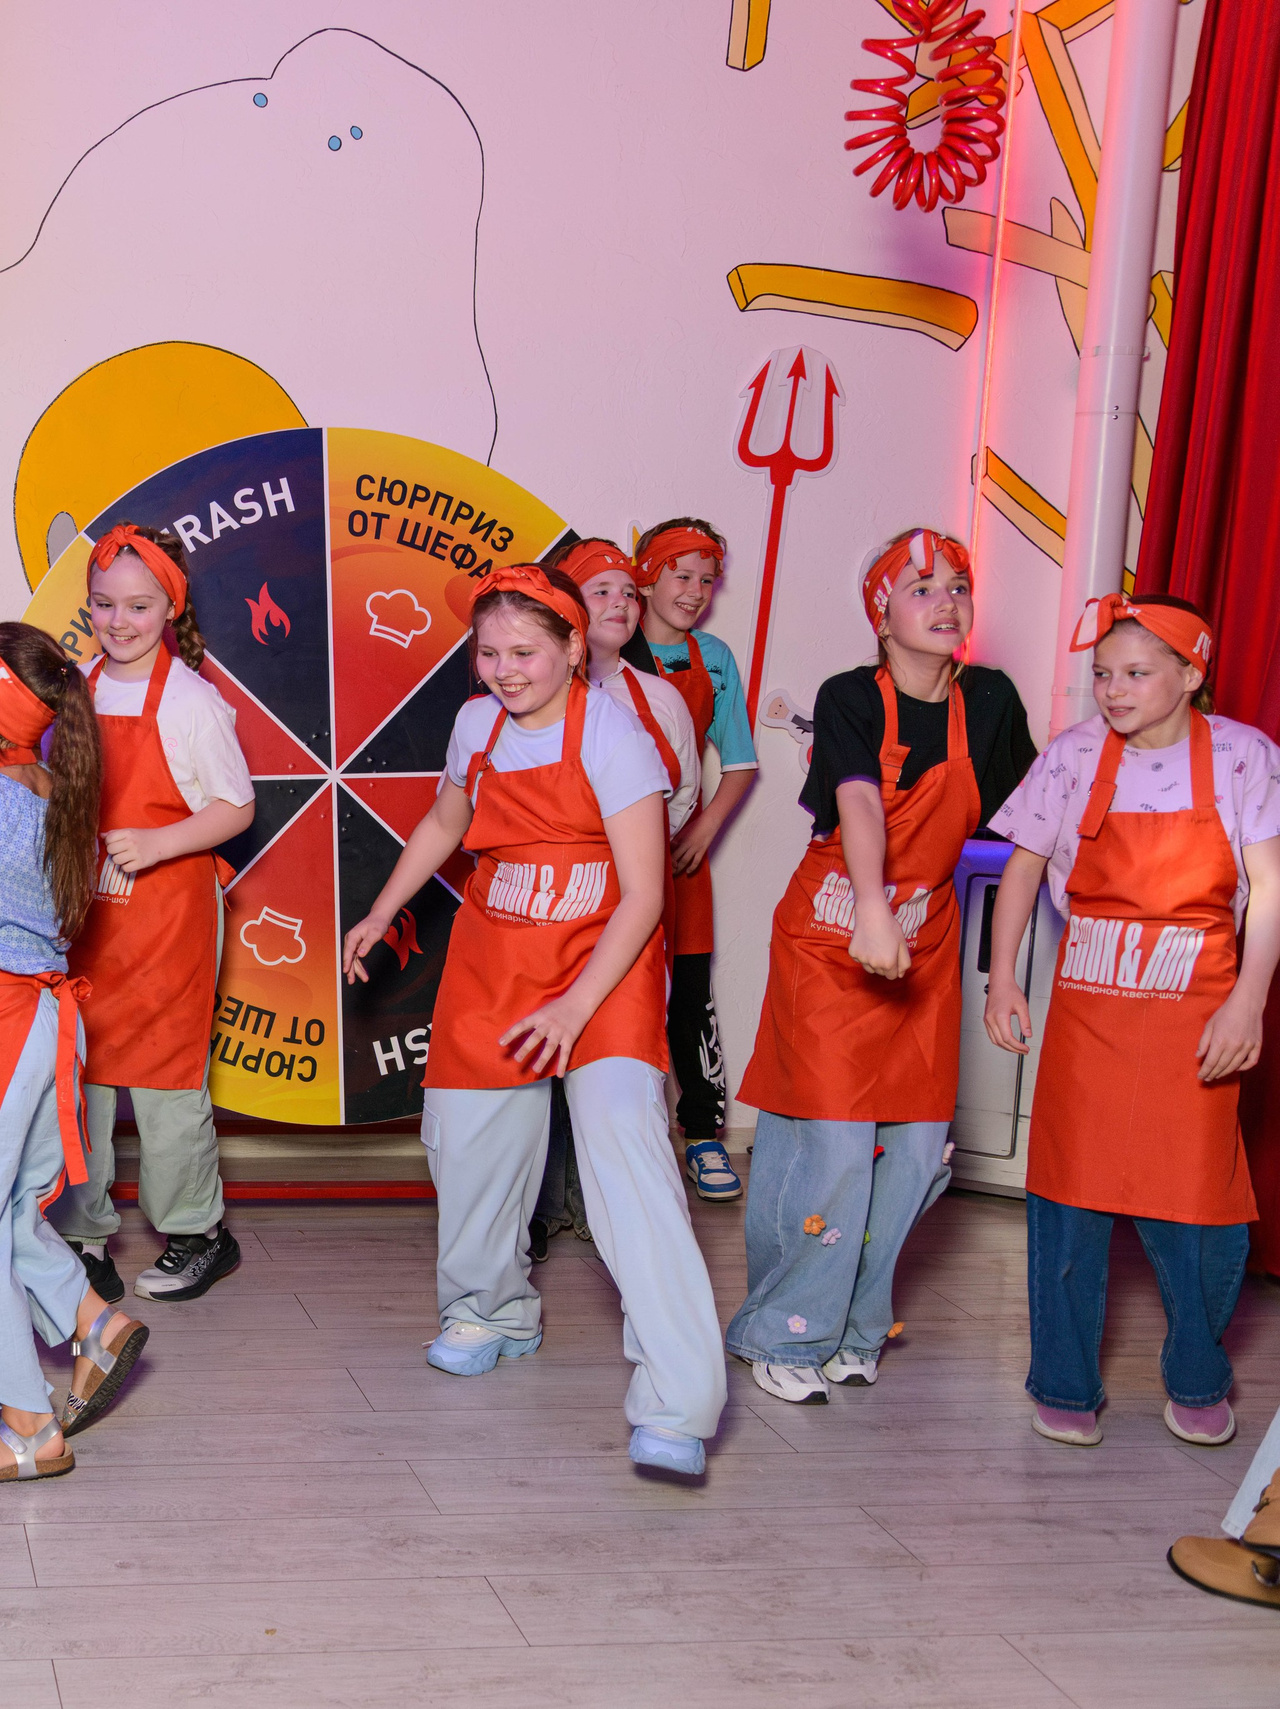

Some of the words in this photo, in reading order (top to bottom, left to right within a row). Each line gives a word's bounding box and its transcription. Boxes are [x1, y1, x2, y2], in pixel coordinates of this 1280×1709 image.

[158, 477, 295, 554] RASH
[348, 510, 390, 540] ОТ
[356, 474, 514, 552] СЮРПРИЗ
[549, 861, 610, 922] RUN
[1060, 914, 1124, 986] COOK
[1116, 922, 1143, 990] &
[1138, 925, 1206, 992] RUN
[1058, 979, 1120, 997] кулинарное
[1121, 989, 1184, 1002] квест-шоу
[282, 1016, 326, 1047] ОТ
